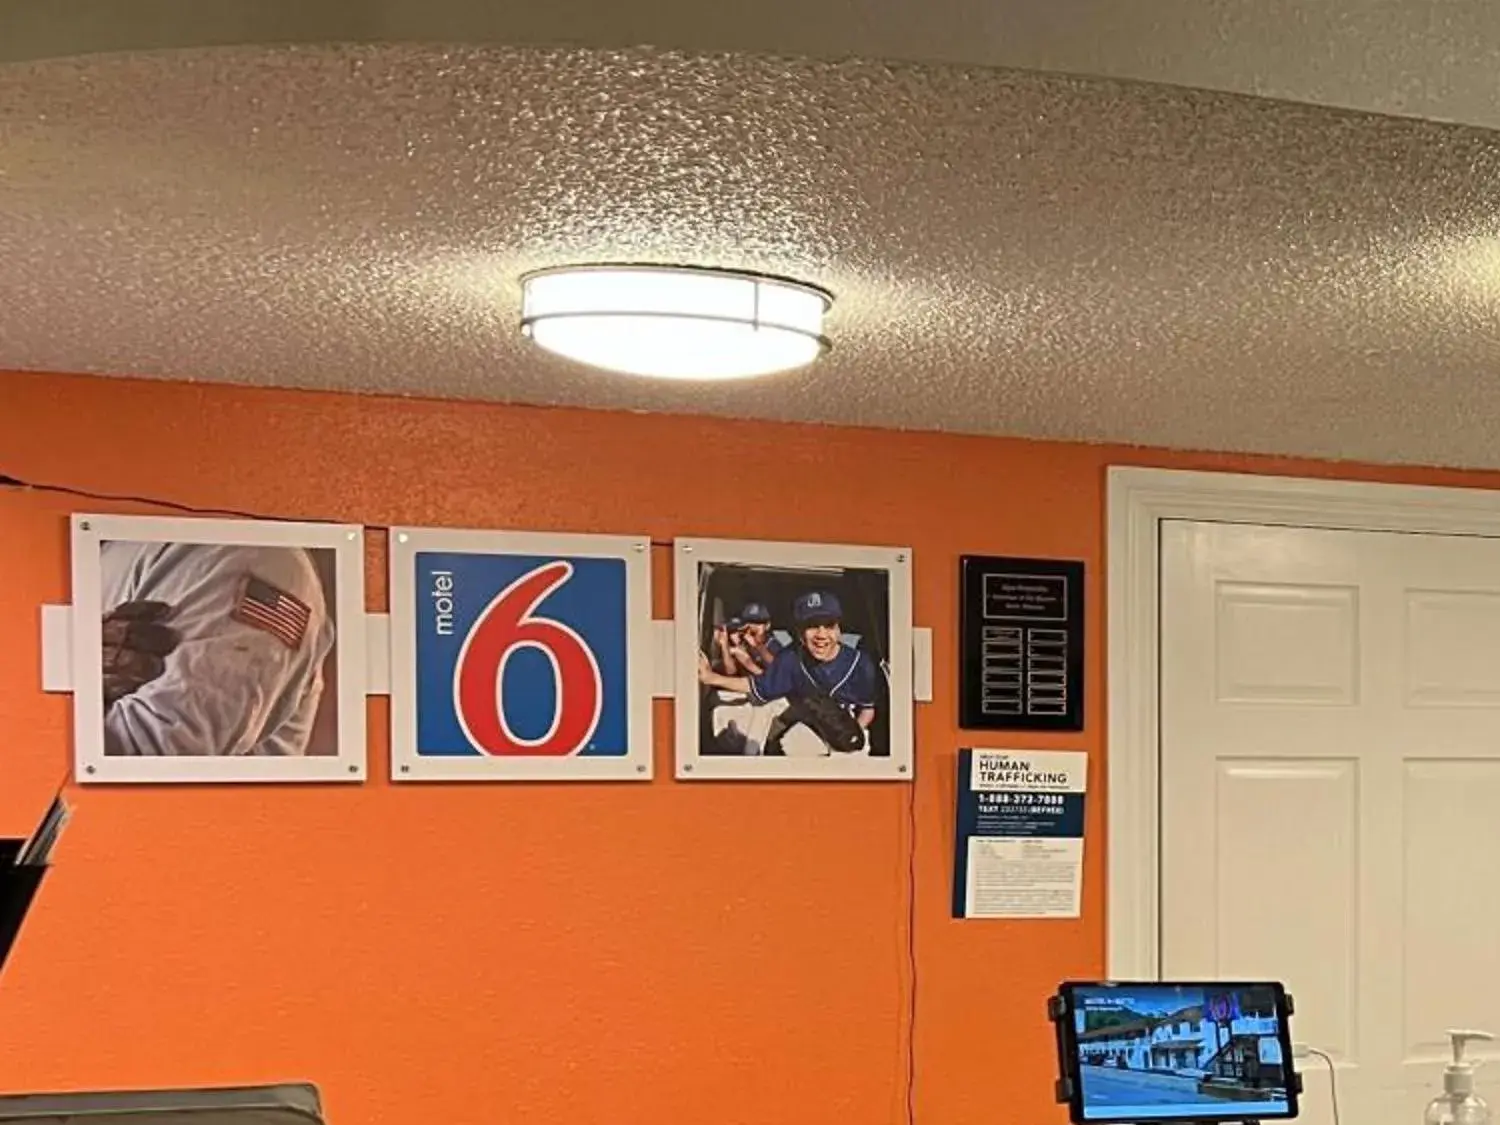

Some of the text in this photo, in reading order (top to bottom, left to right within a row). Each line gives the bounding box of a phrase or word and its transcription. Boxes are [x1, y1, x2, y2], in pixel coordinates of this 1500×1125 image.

[431, 571, 454, 635] motel
[453, 560, 603, 758] 6
[979, 760, 1030, 771] HUMAN
[979, 771, 1068, 784] TRAFFICKING
